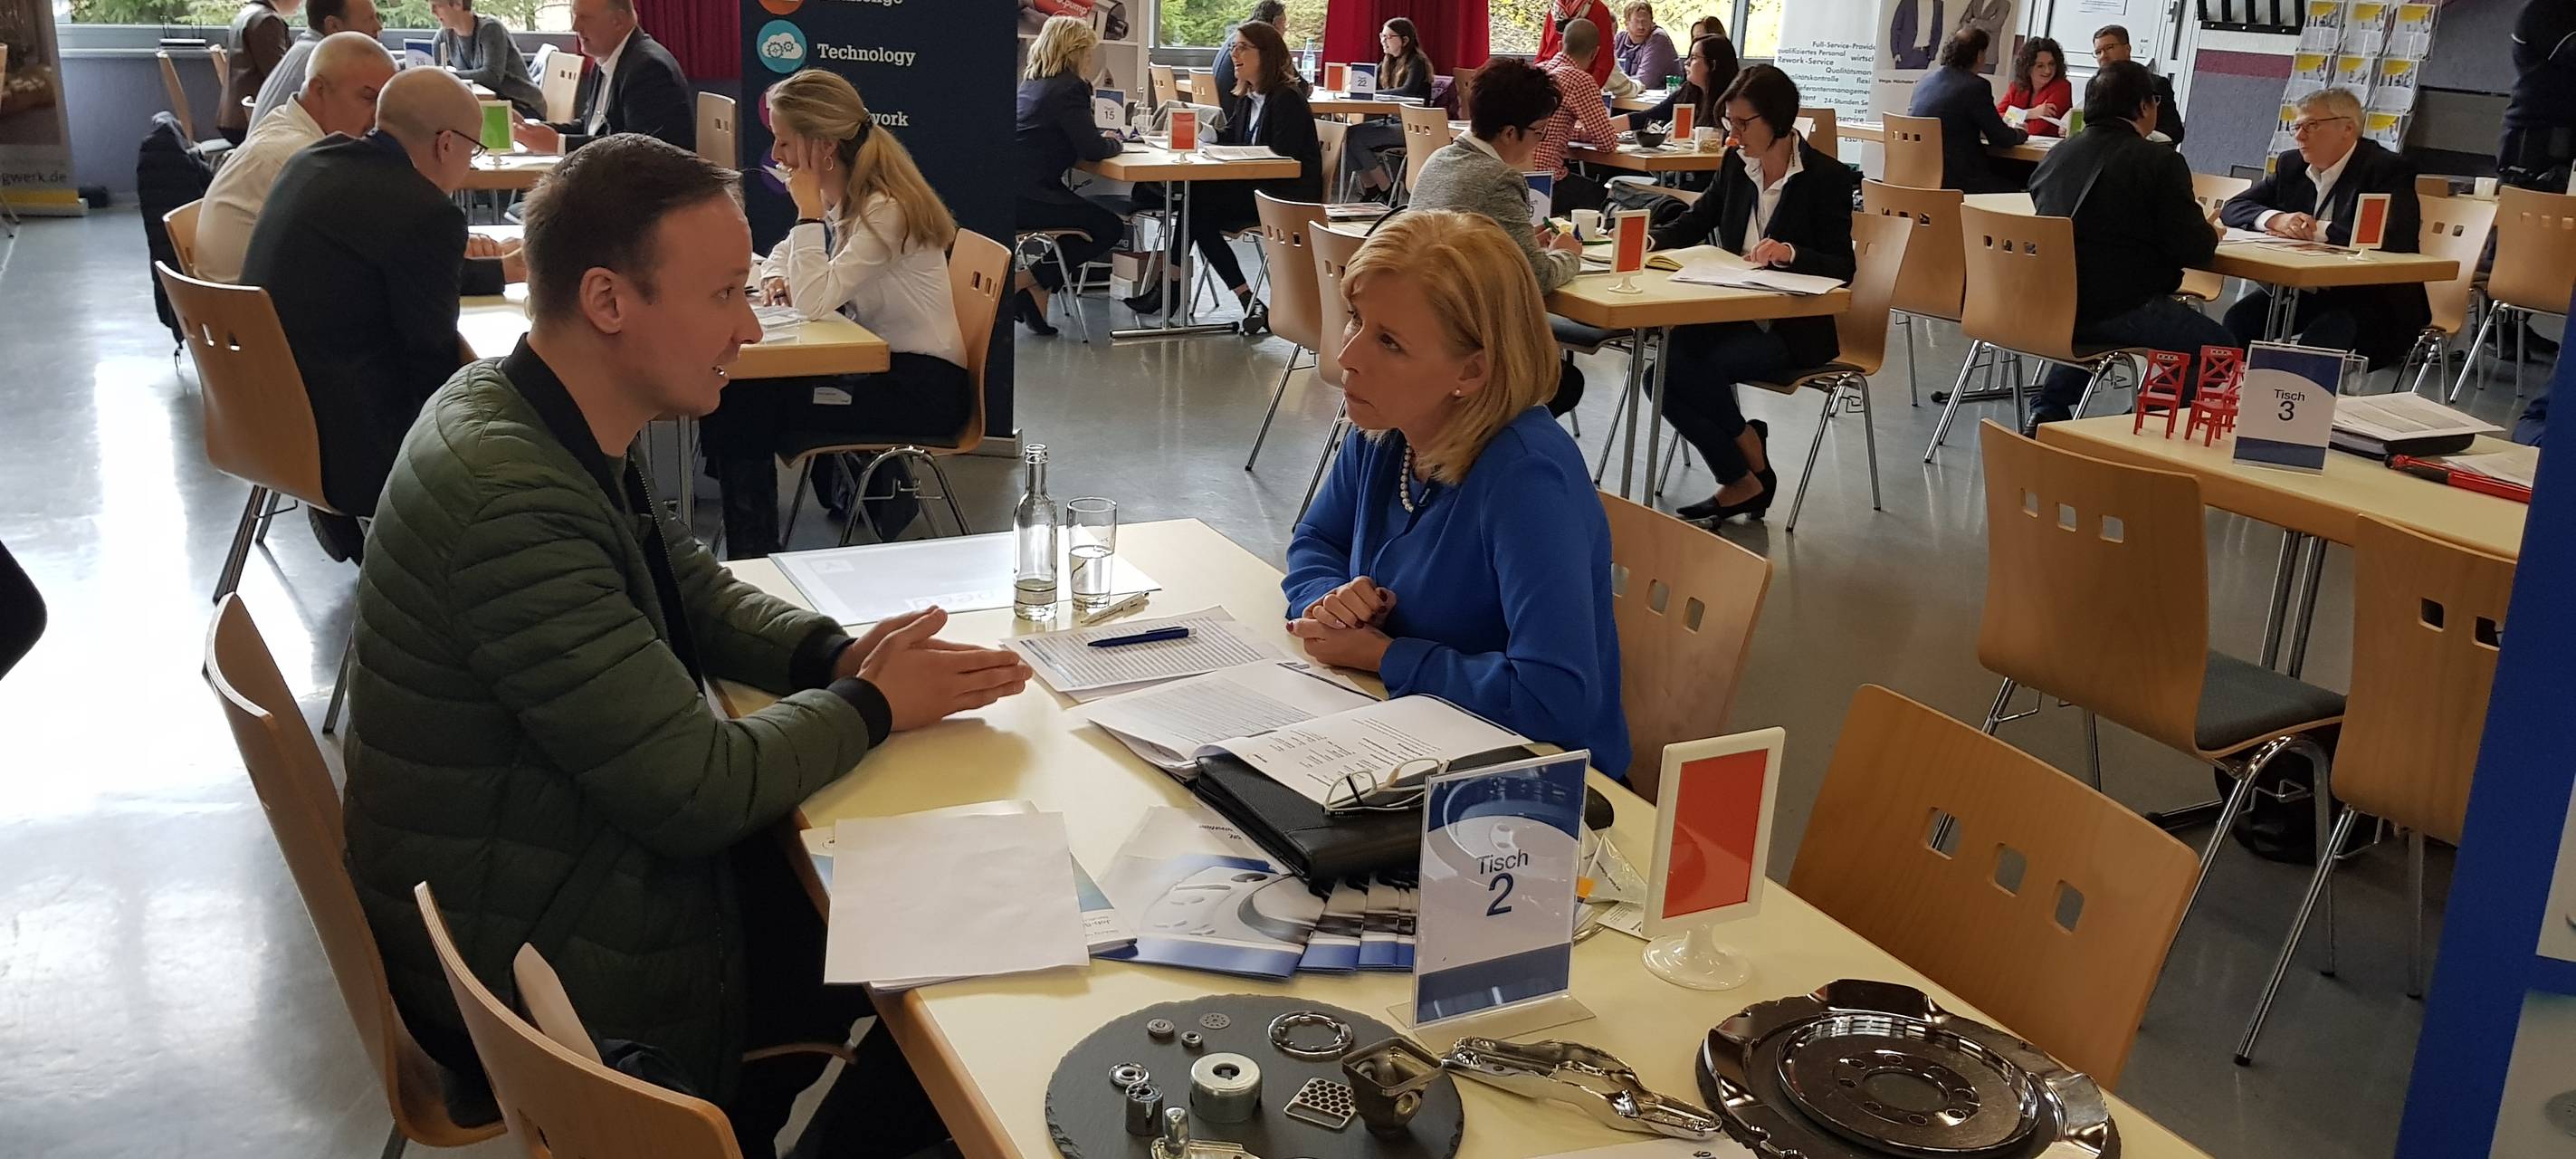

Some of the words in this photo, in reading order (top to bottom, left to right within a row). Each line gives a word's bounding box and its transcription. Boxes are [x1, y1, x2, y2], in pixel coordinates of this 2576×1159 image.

[816, 43, 916, 66] Technology
[1818, 48, 1846, 57] Personal
[1358, 79, 1368, 87] 22
[1104, 110, 1115, 120] 15
[2274, 388, 2305, 401] Tisch
[2277, 400, 2295, 421] 3
[1476, 848, 1529, 875] Tisch
[1486, 872, 1514, 916] 2
